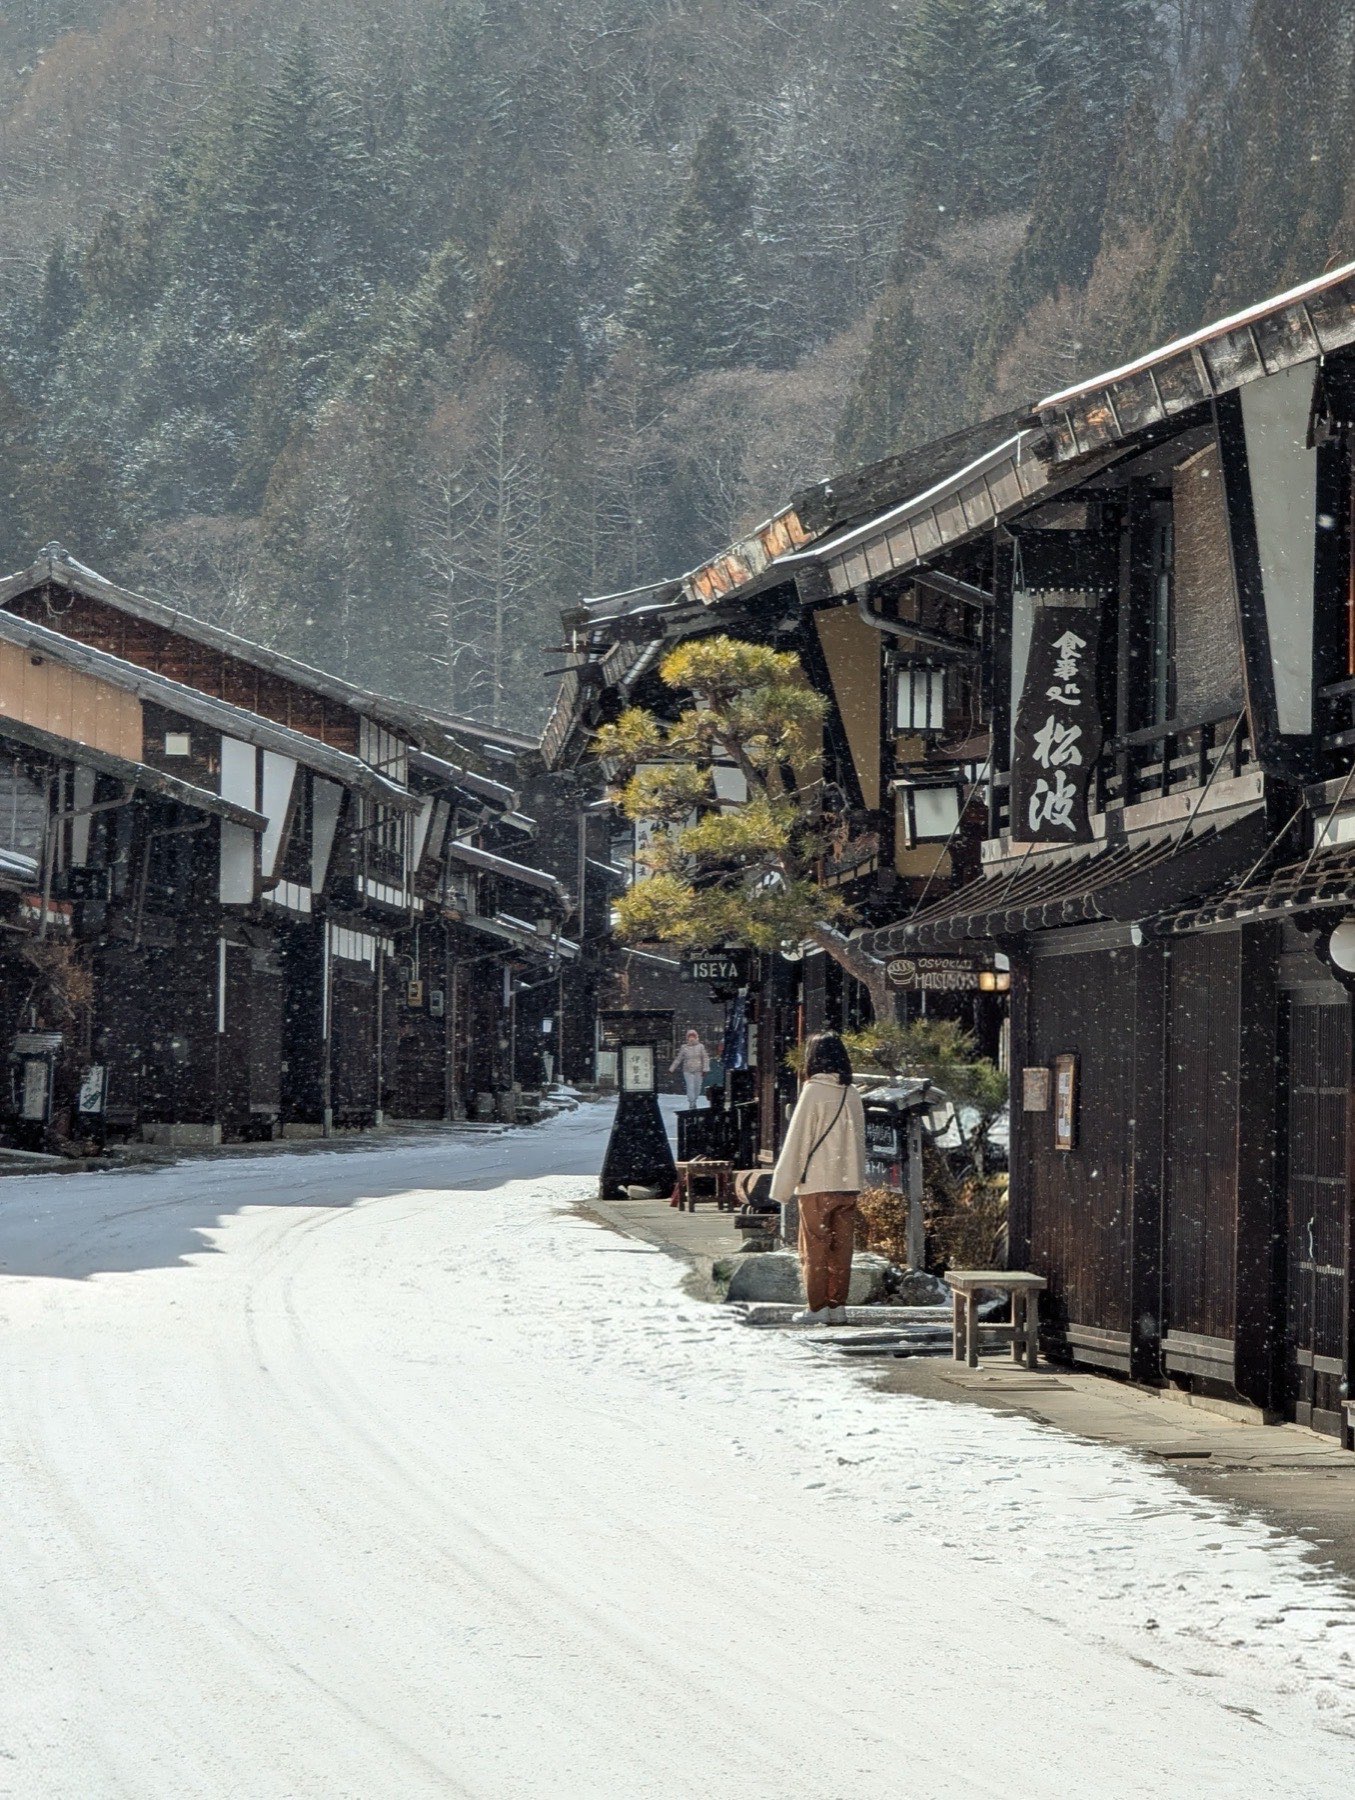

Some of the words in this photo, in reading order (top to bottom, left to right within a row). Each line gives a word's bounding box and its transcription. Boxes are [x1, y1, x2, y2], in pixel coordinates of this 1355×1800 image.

[1046, 630, 1087, 706] 食事処
[1029, 714, 1083, 832] 松波
[693, 962, 738, 978] ISEYA
